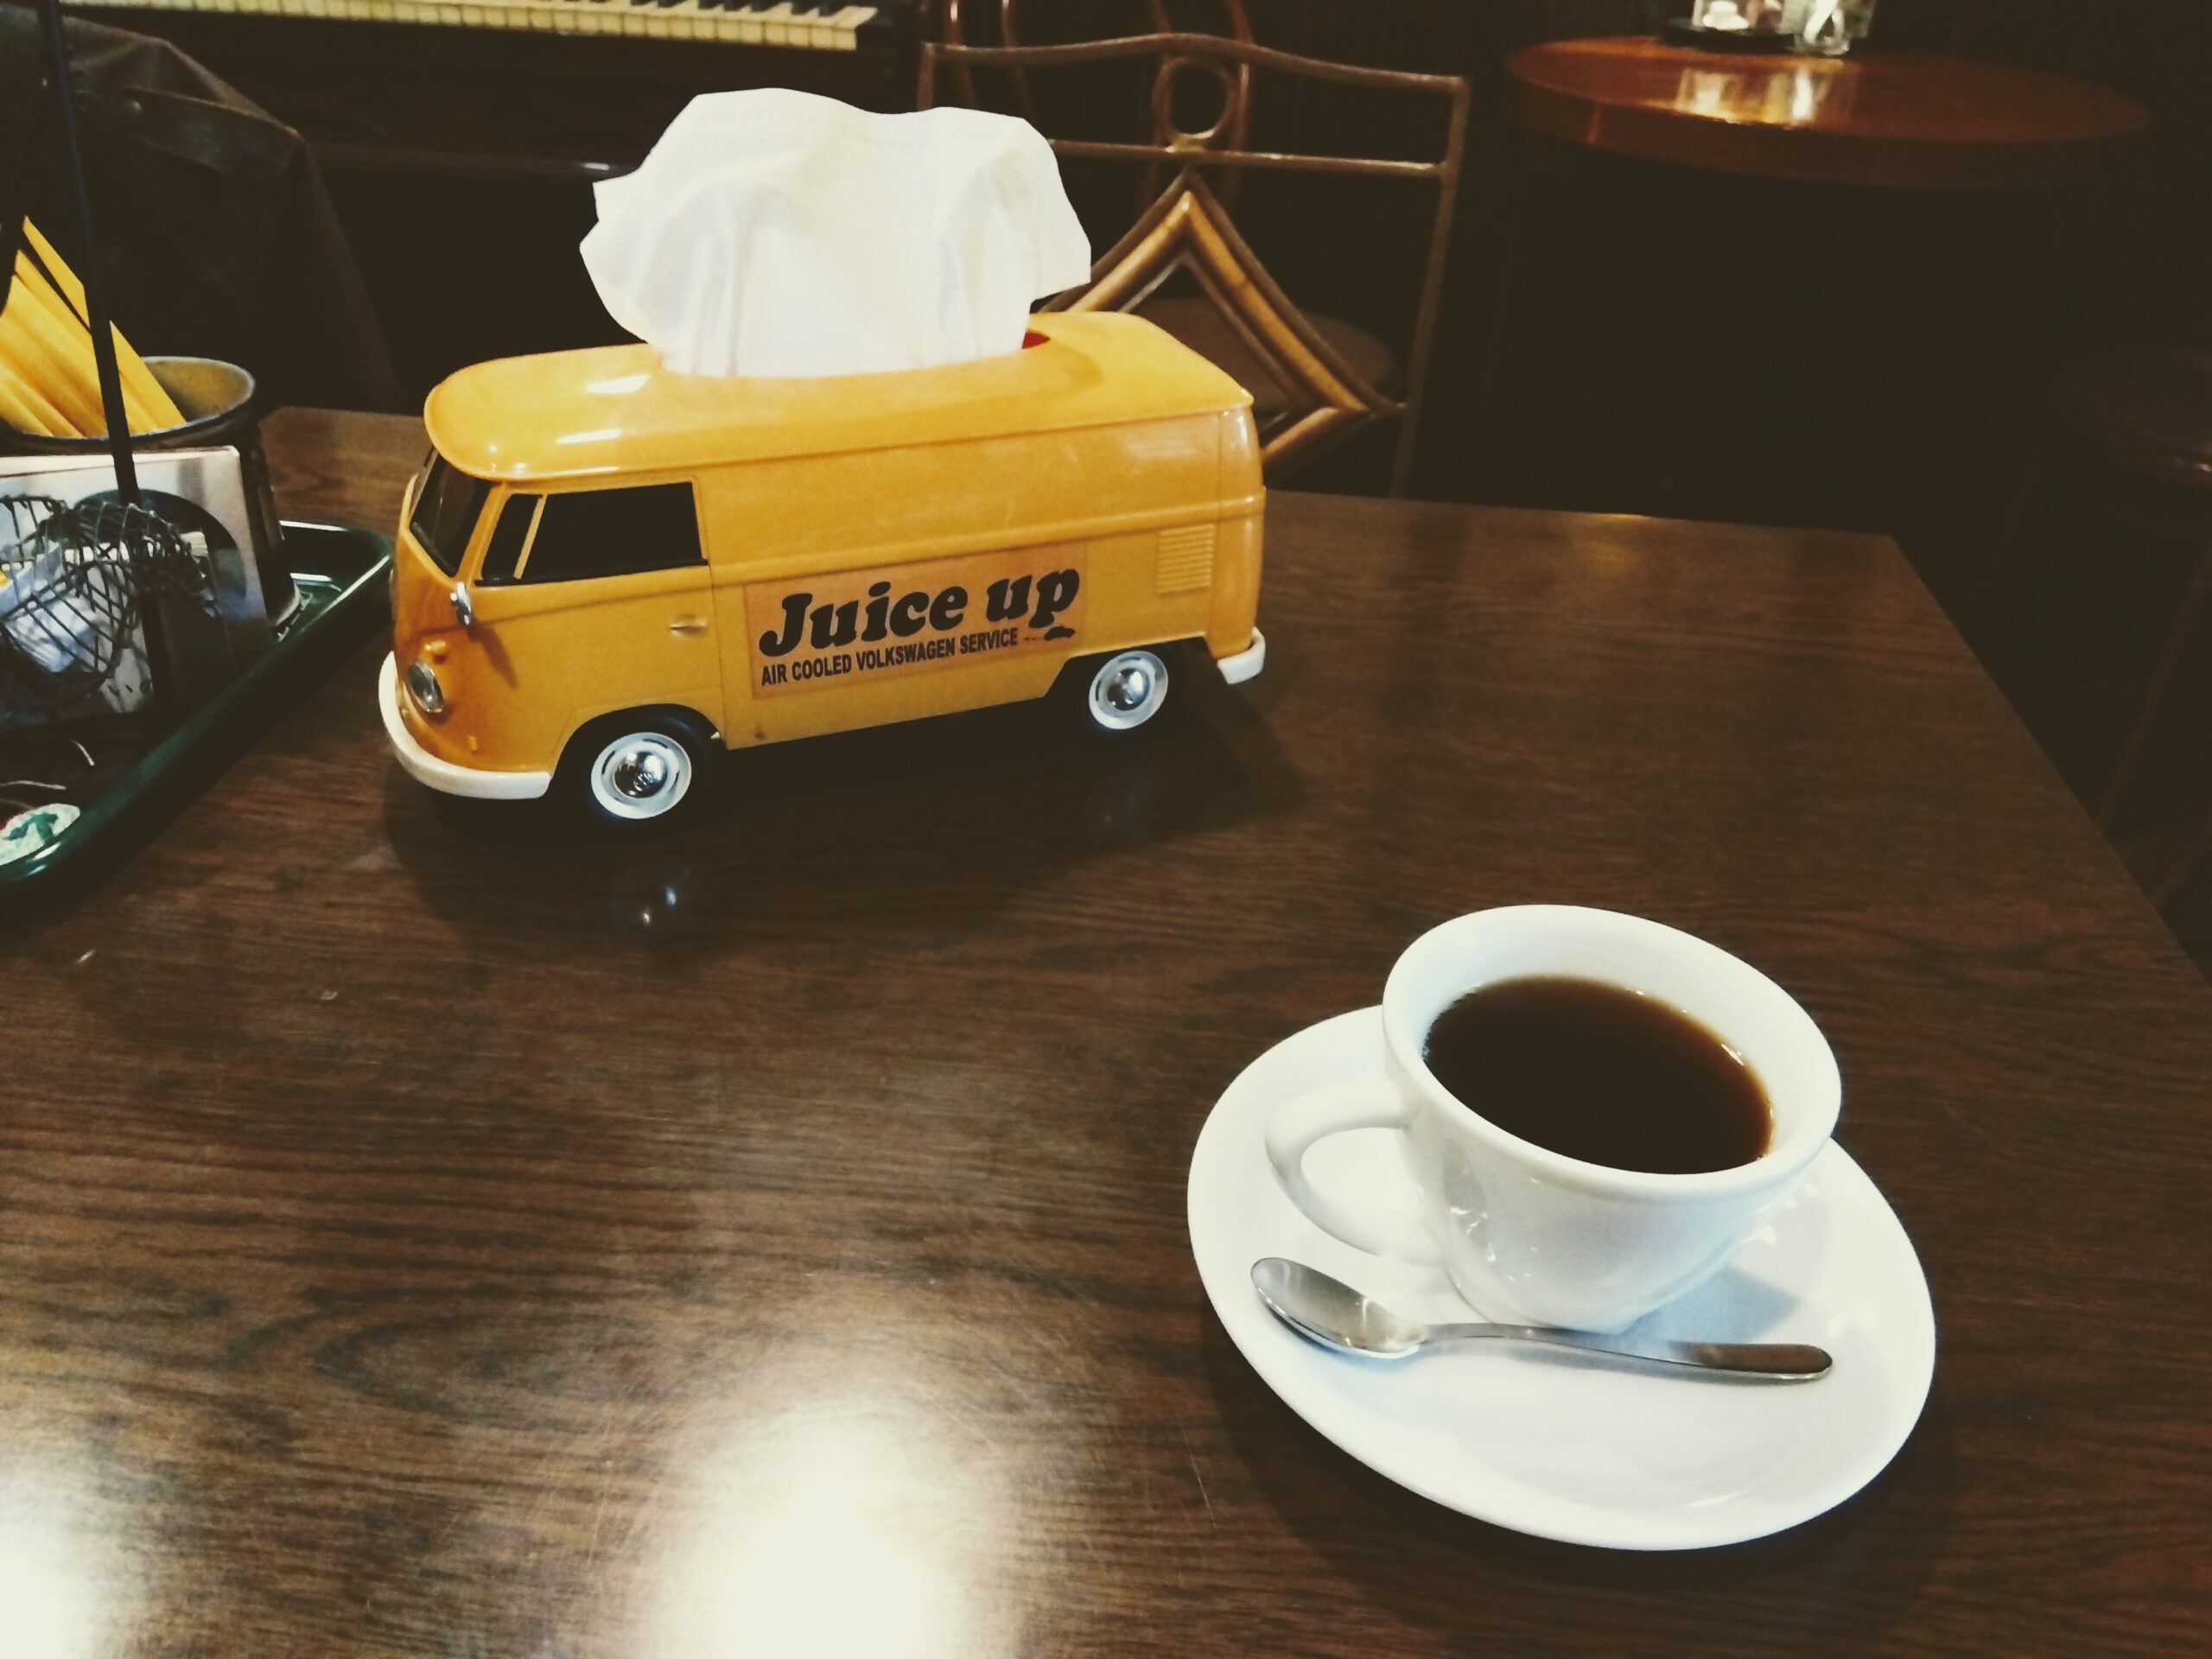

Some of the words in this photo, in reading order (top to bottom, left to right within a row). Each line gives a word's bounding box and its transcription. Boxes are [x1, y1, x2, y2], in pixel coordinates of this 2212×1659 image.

[759, 582, 969, 657] Juice
[987, 569, 1080, 628] up
[761, 664, 788, 686] AIR
[791, 654, 852, 681] COOLED
[856, 638, 956, 669] VOLKSWAGEN
[960, 627, 1018, 655] SERVICE
